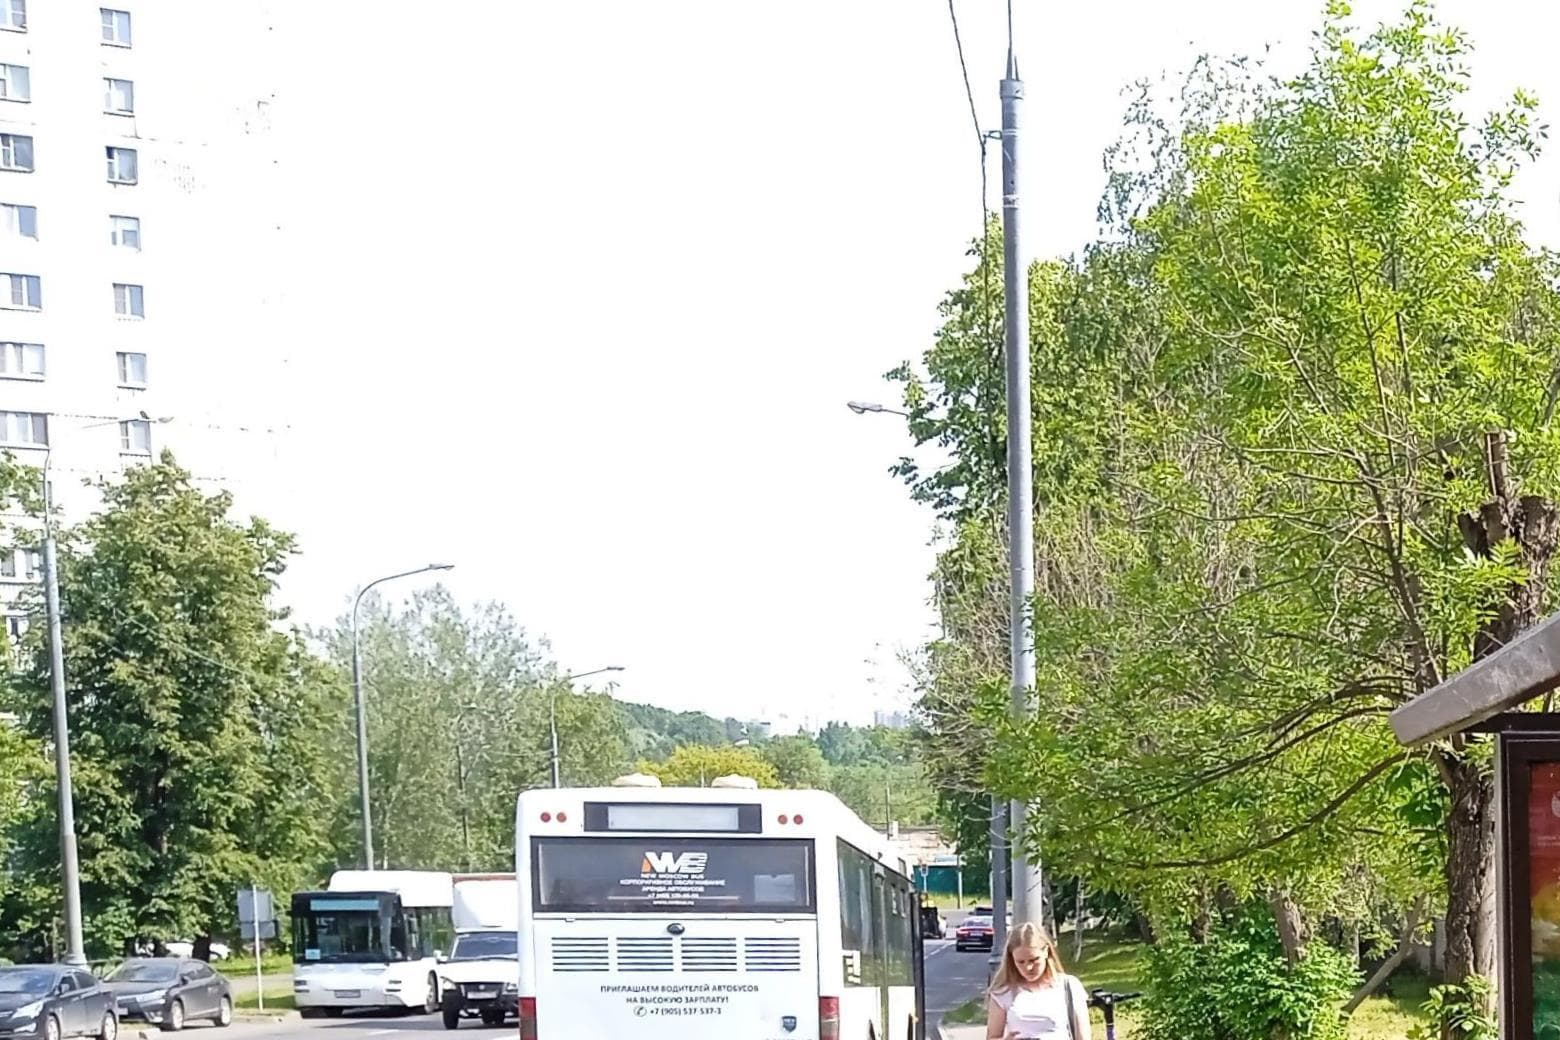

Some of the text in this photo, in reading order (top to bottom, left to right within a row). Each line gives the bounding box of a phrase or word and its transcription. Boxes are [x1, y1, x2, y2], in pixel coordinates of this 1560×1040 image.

[600, 983, 759, 993] ПРИГЛАШАЕМ ВОДИТЕЛЕЙ АВТОБУСОВ
